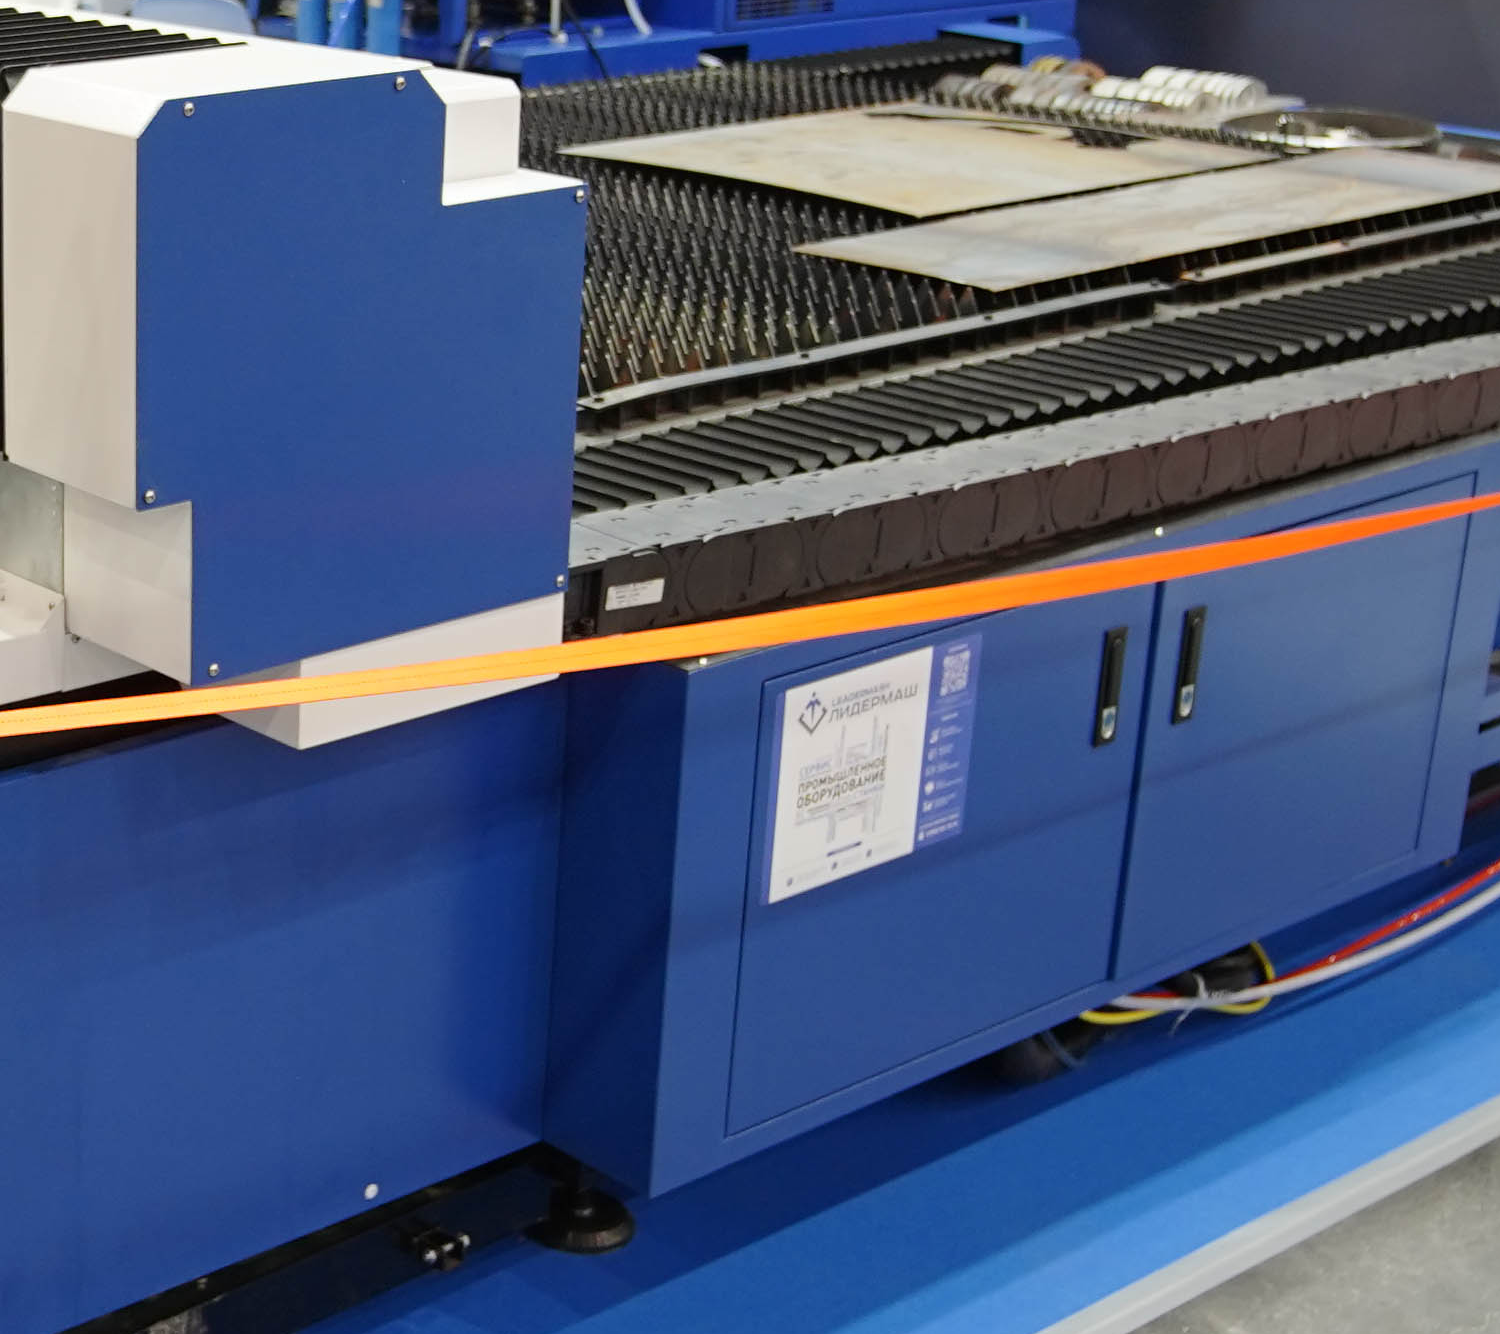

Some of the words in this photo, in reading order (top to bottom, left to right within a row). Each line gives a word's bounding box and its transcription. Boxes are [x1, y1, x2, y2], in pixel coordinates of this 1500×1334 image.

[829, 683, 918, 723] ЛИДЕРМАШ
[797, 767, 886, 808] ОБОРУДОВАНИЕ
[798, 755, 887, 795] ПРОМЫШЛЕННОЕ
